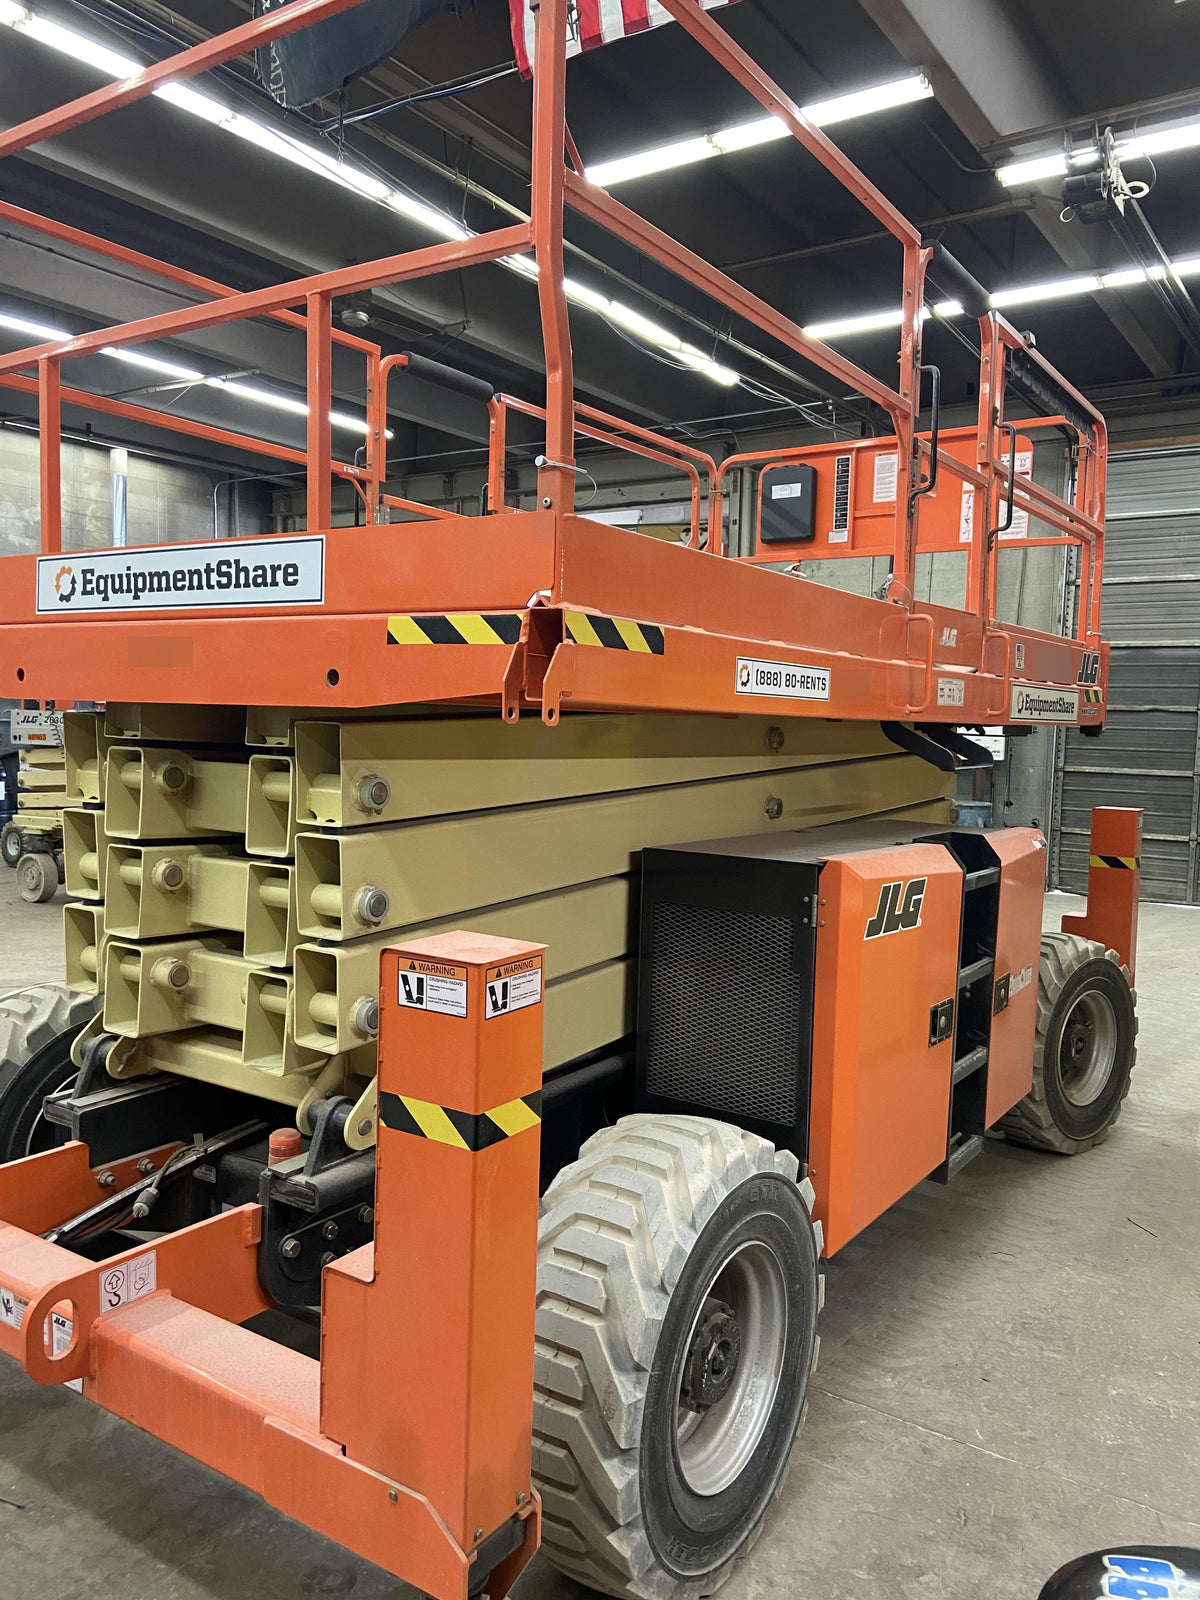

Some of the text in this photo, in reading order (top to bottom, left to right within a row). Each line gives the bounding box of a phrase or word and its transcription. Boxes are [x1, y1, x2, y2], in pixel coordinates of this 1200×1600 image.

[81, 559, 299, 601] EquipmentShare
[755, 668, 827, 691] (888) 80-RENTS
[1077, 652, 1100, 685] JLG
[1025, 693, 1075, 715] EquipmentShare
[21, 715, 38, 724] JLG
[864, 877, 928, 941] JLG
[418, 962, 456, 977] WARNING
[504, 960, 534, 975] WARNING
